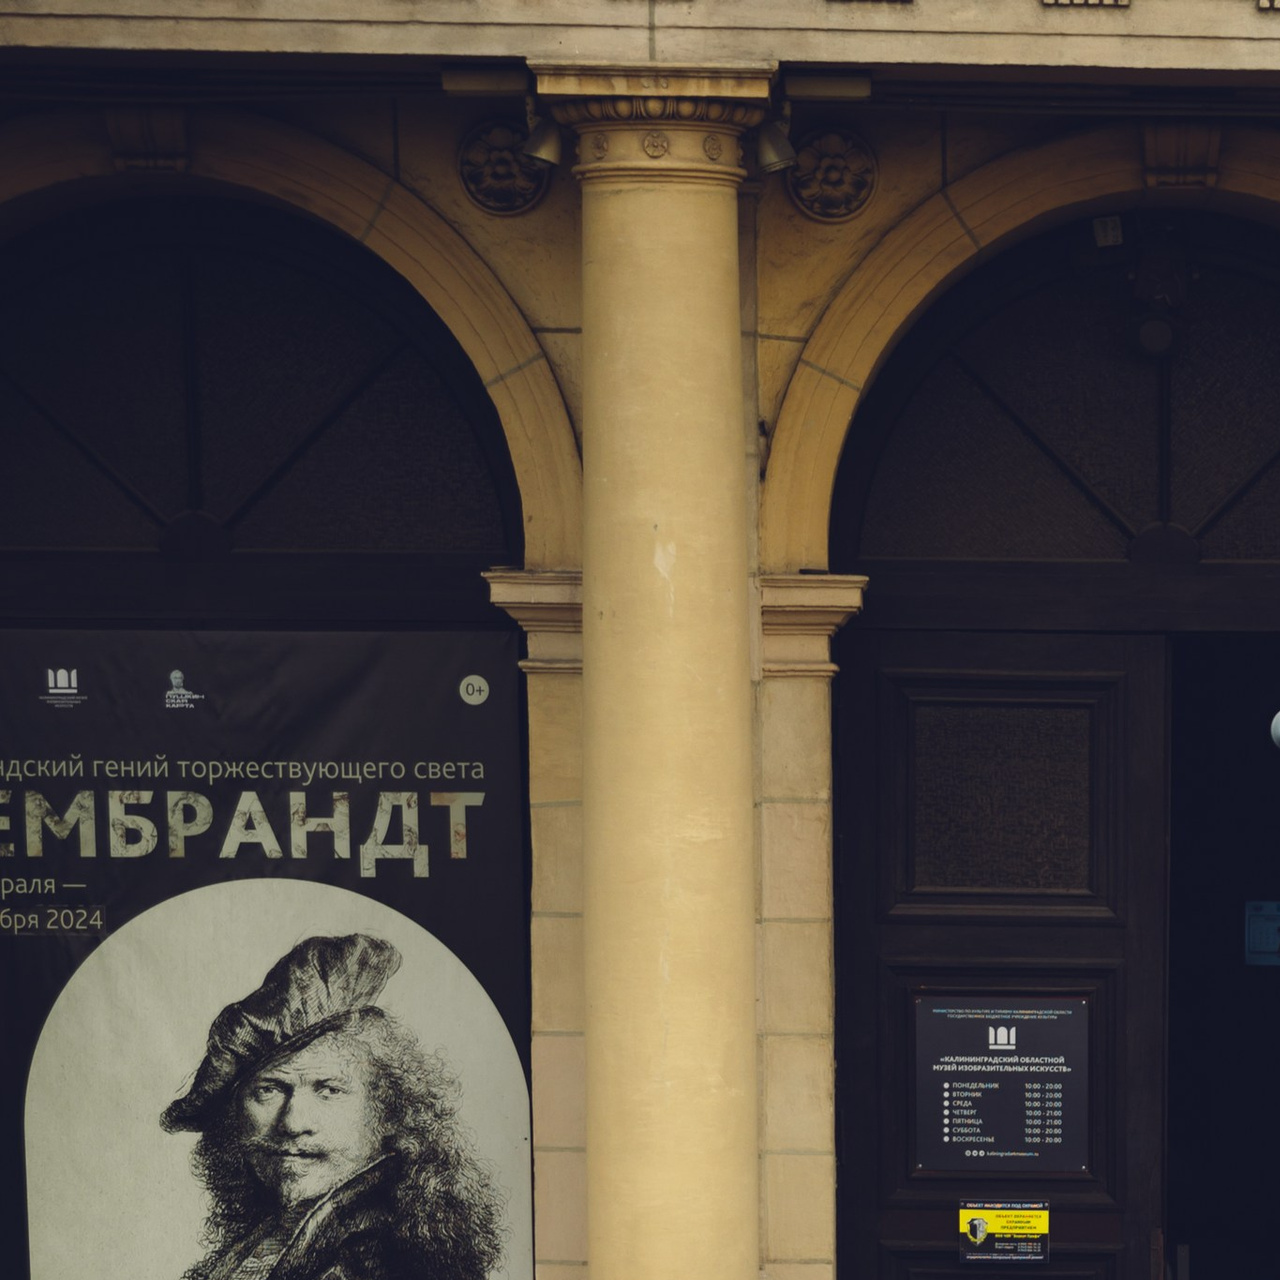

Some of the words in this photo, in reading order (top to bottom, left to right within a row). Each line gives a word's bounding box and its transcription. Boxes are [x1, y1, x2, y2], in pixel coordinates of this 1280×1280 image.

[466, 682, 485, 697] 0+
[93, 754, 169, 778] гений
[177, 760, 406, 786] торжествующего
[414, 761, 485, 780] света
[1, 877, 55, 901] раля
[0, 908, 39, 935] бря
[46, 909, 103, 930] 2024
[933, 1064, 957, 1072] МУЗЕЙ
[1030, 1065, 1072, 1073] ИСКУССТВ»
[940, 1055, 1019, 1064] «КАЛИНИНГРАДСКИЙ
[1020, 1056, 1065, 1064] ОБЛАСТНОЙ
